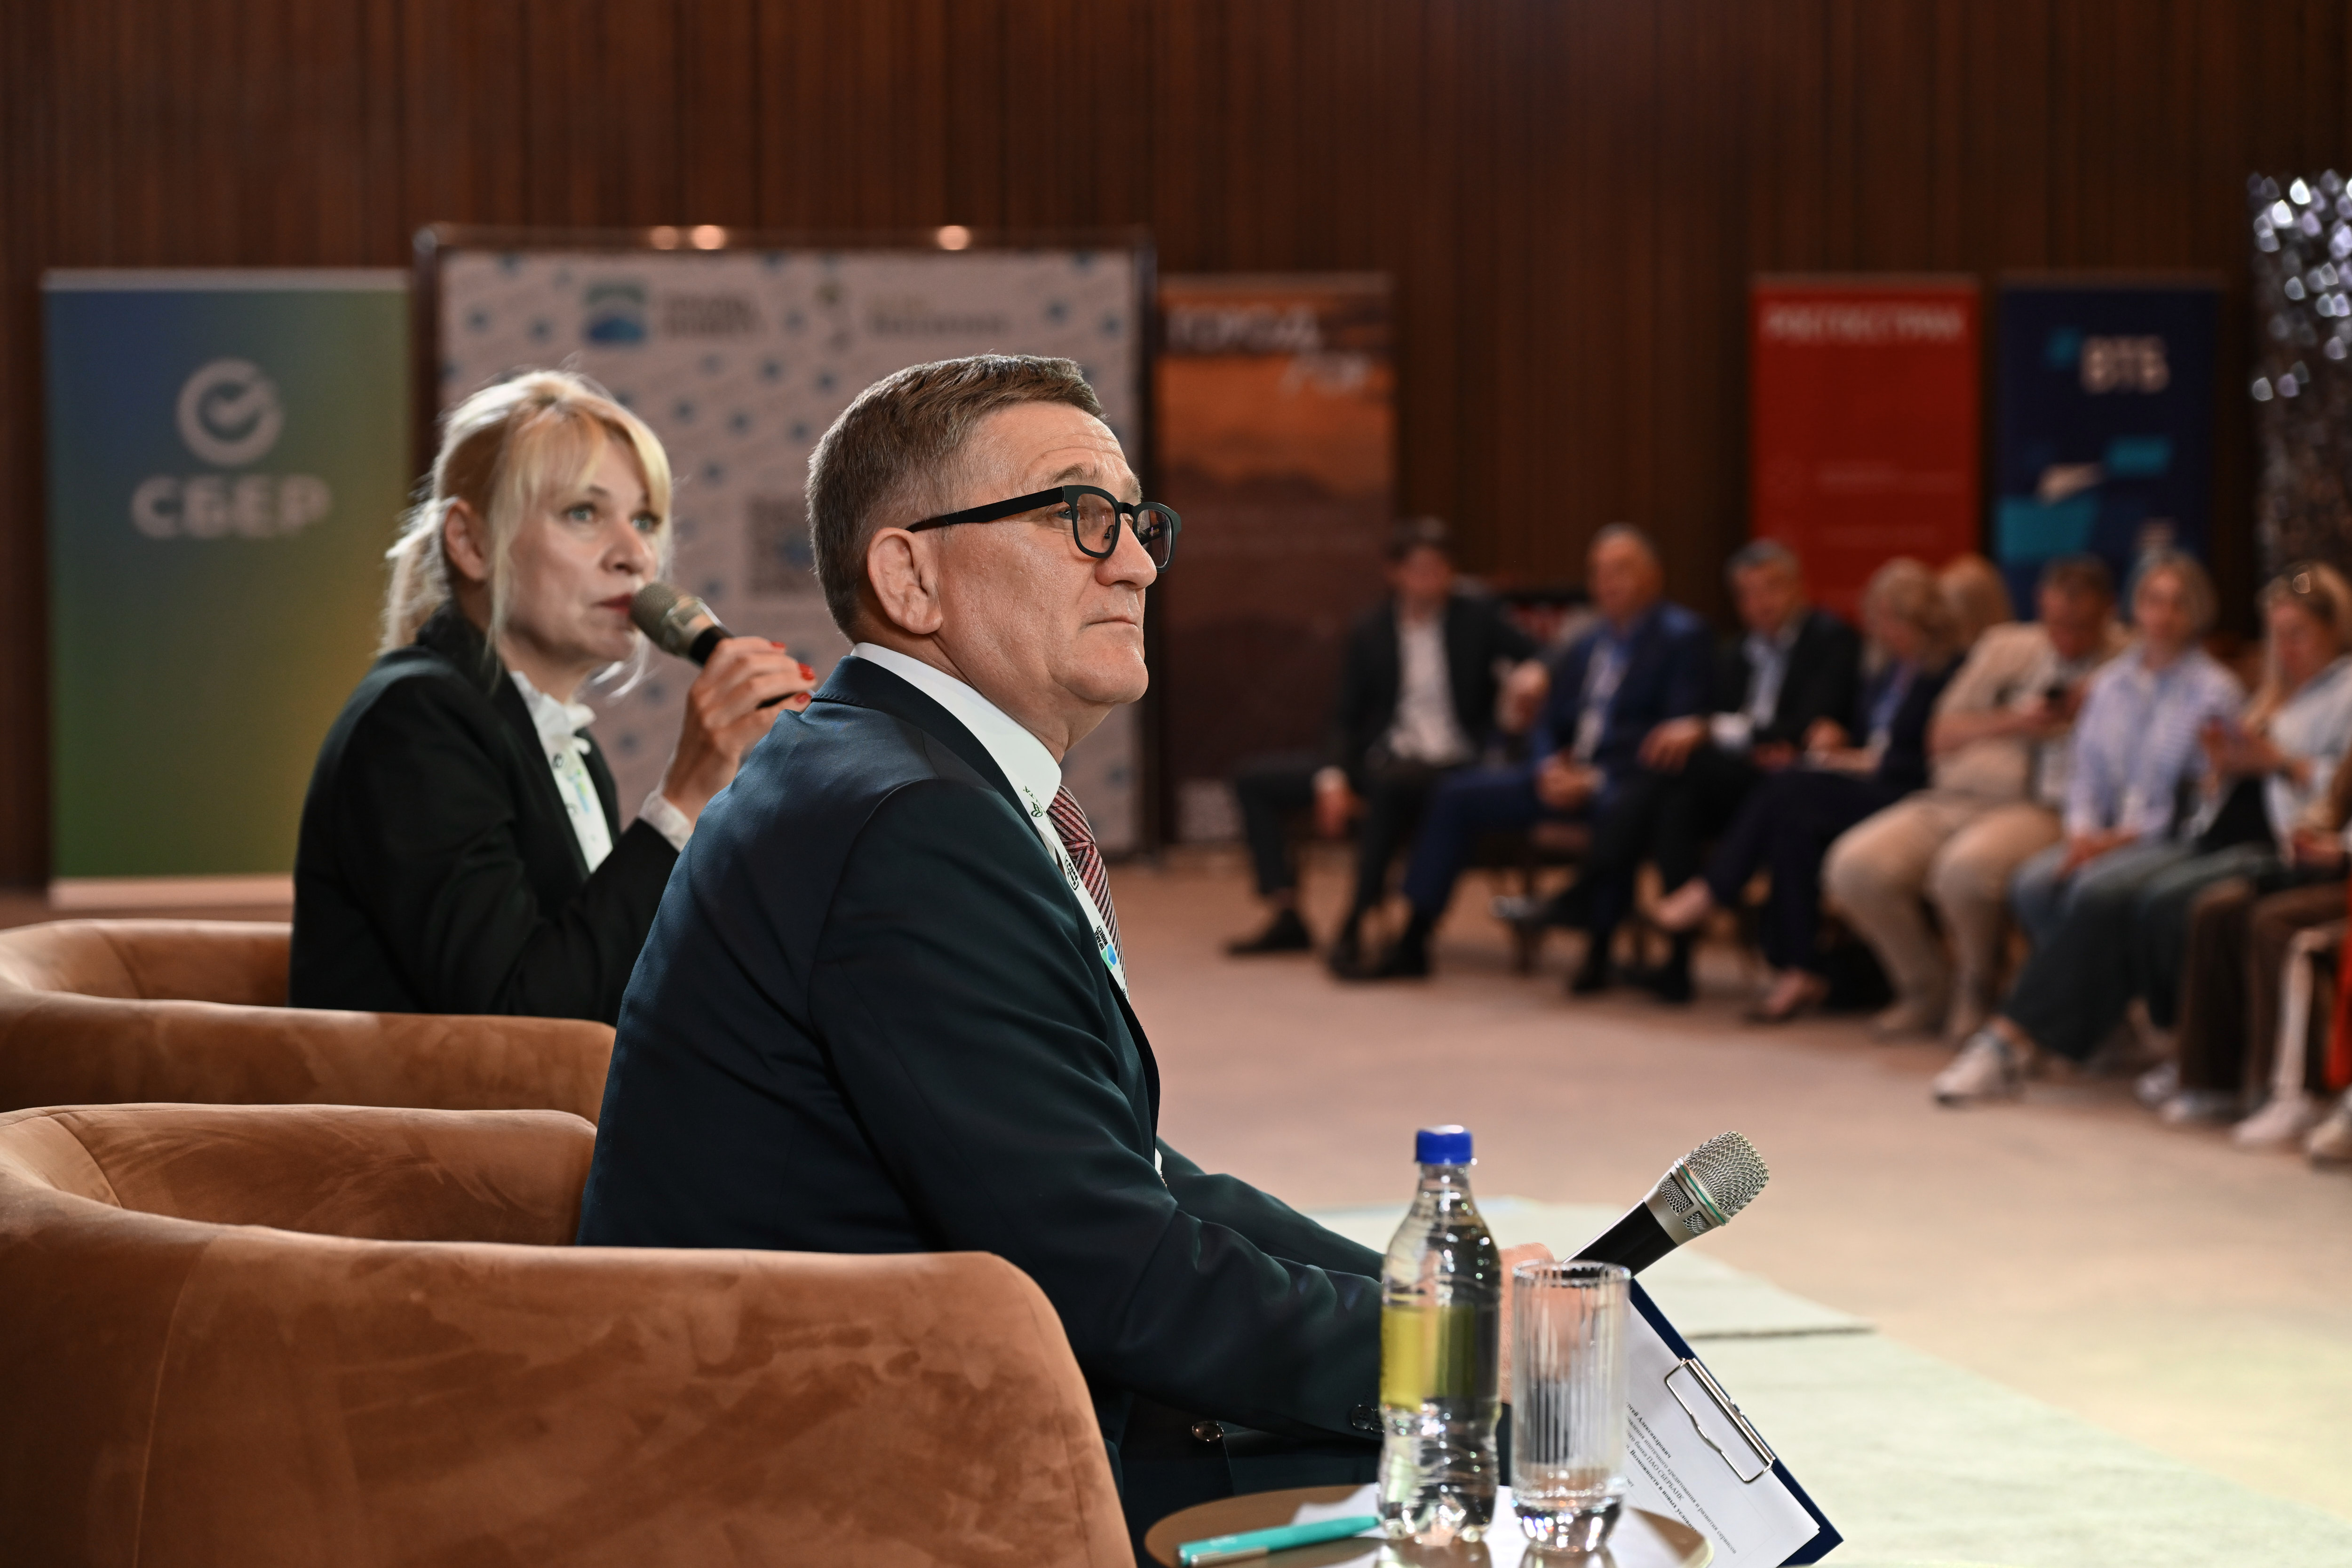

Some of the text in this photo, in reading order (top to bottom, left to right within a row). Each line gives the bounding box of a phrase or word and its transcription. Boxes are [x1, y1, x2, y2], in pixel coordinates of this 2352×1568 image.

[131, 474, 332, 538] СБЕР
[1097, 925, 1108, 946] ИНВЕСТ
[1625, 1399, 1671, 1458] ергей Александрович
[1630, 1449, 1660, 1486] Возможности
[1662, 1490, 1677, 1509] новых
[1634, 1441, 1647, 1457] банка
[1646, 1456, 1659, 1471] ПАО
[1658, 1470, 1684, 1501] СБЕРБАНК
[1644, 1439, 1669, 1469] ипотечного
[1667, 1468, 1696, 1503] кредитования
[1697, 1507, 1718, 1531] развития
[1717, 1531, 1736, 1554] сервисов
